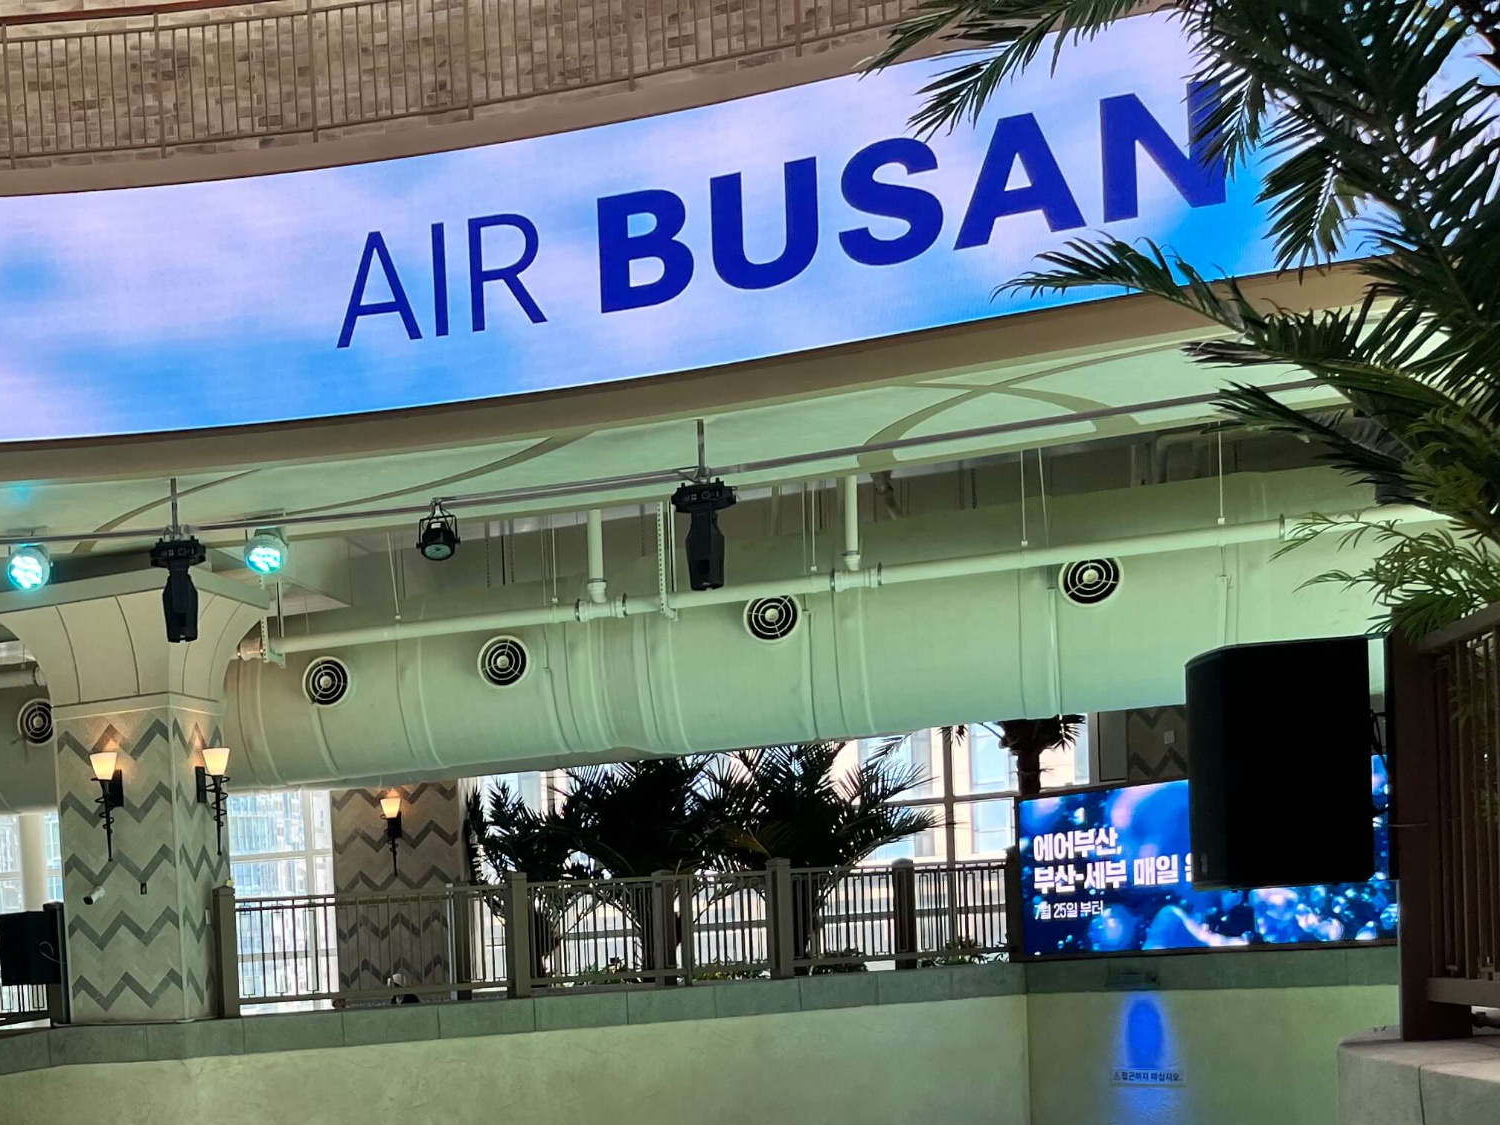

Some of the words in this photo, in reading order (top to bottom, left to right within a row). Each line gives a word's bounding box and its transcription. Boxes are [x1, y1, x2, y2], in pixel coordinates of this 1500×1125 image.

[338, 213, 546, 349] AIR
[598, 81, 1226, 313] BUSAN
[1033, 827, 1122, 861] 에어부산,
[1034, 860, 1127, 894] 부산-세부
[1134, 854, 1179, 885] 매일
[1035, 903, 1051, 919] 7월
[1054, 902, 1078, 918] 25일
[1080, 900, 1104, 917] 부터
